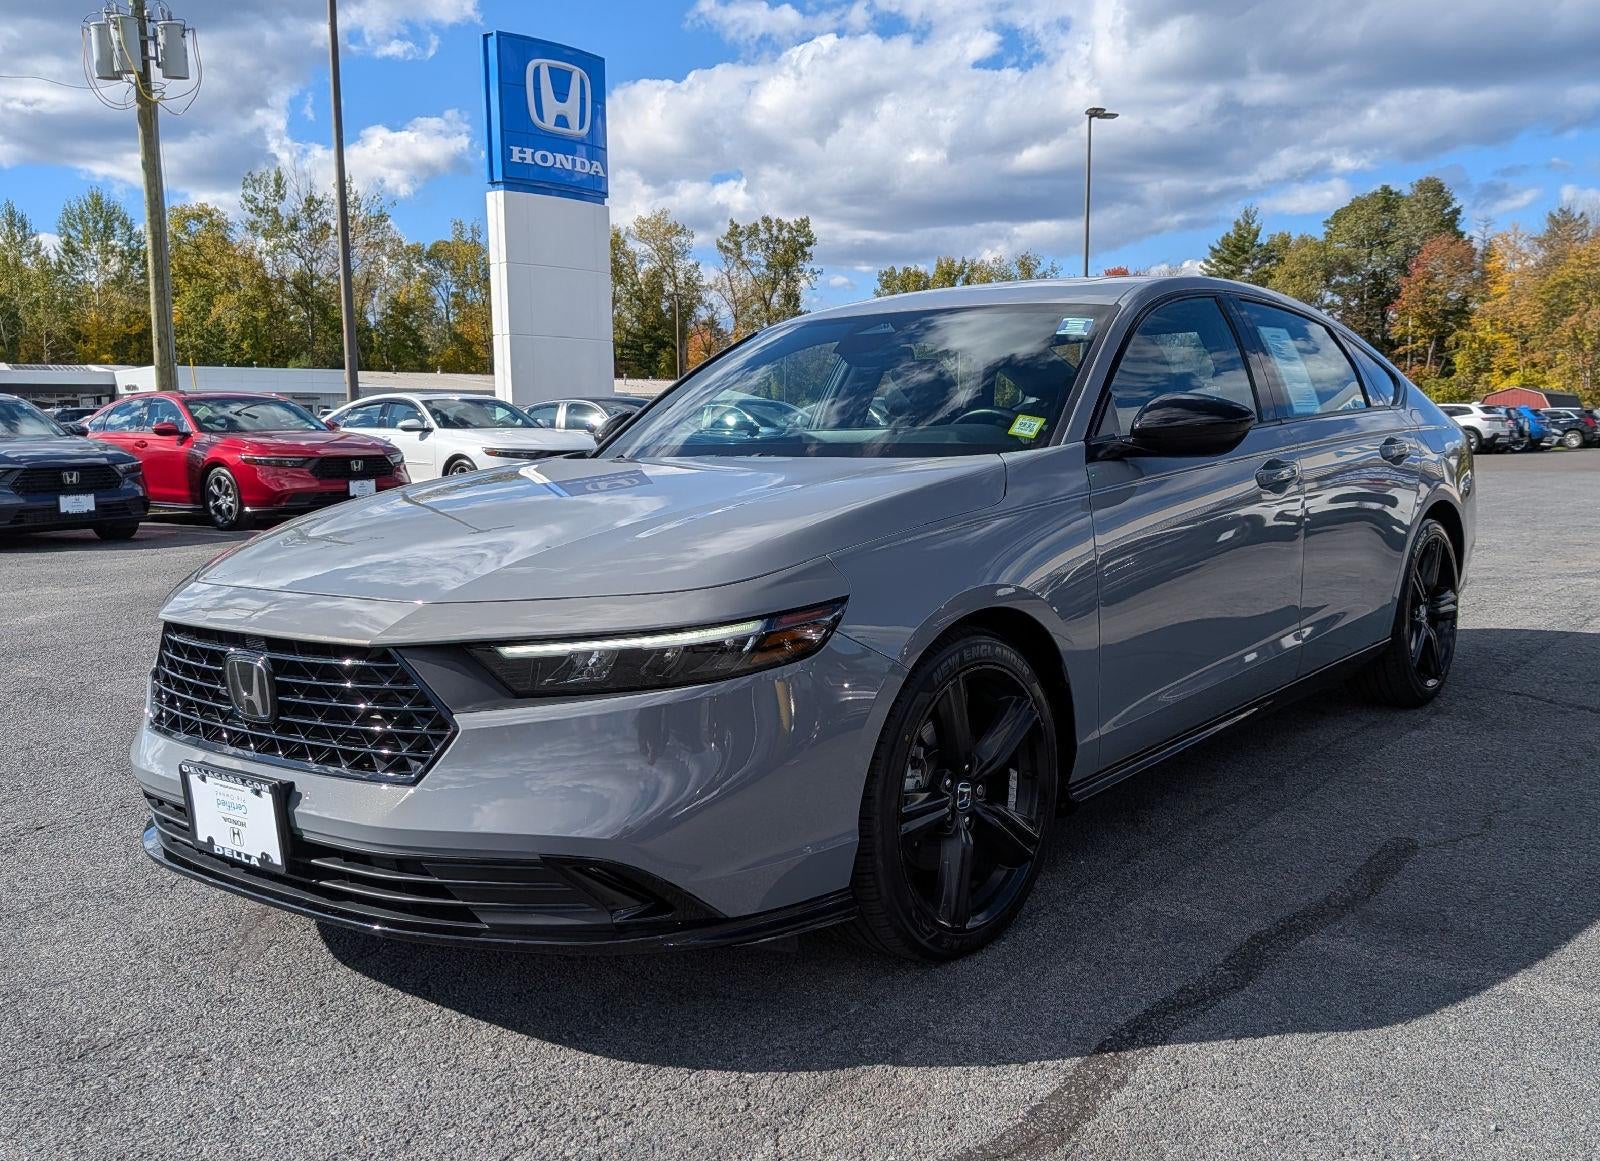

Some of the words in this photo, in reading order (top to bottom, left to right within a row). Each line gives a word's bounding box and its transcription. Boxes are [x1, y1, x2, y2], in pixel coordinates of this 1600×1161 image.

[510, 146, 606, 177] HONDA
[933, 655, 960, 682] NEW
[963, 645, 1030, 677] ENGLANDER
[181, 765, 269, 793] DELLACARS.COM
[216, 798, 248, 815] Certified
[222, 816, 247, 828] HONDA
[214, 846, 260, 866] DELLA
